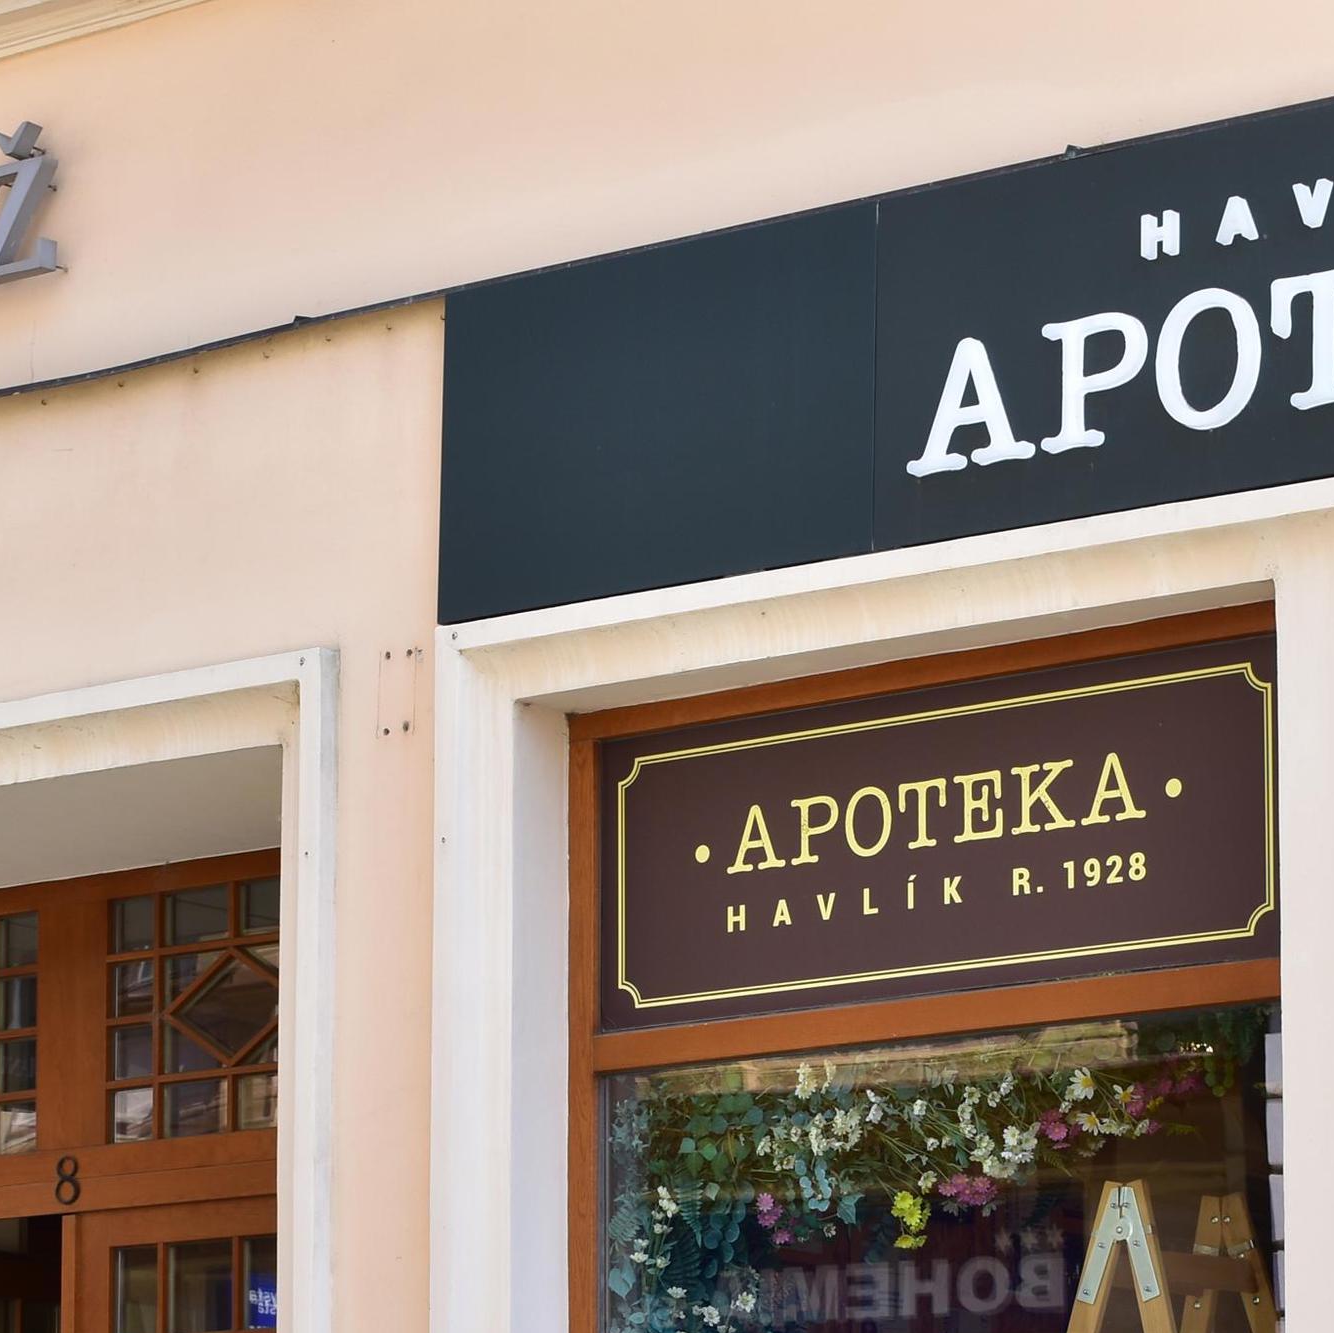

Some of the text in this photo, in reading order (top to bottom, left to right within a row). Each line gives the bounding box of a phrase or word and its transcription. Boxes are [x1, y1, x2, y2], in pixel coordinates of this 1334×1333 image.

[726, 752, 1147, 875] APOTEKA
[727, 852, 1147, 933] HAVLÍK R. 1928
[53, 1155, 82, 1205] 8
